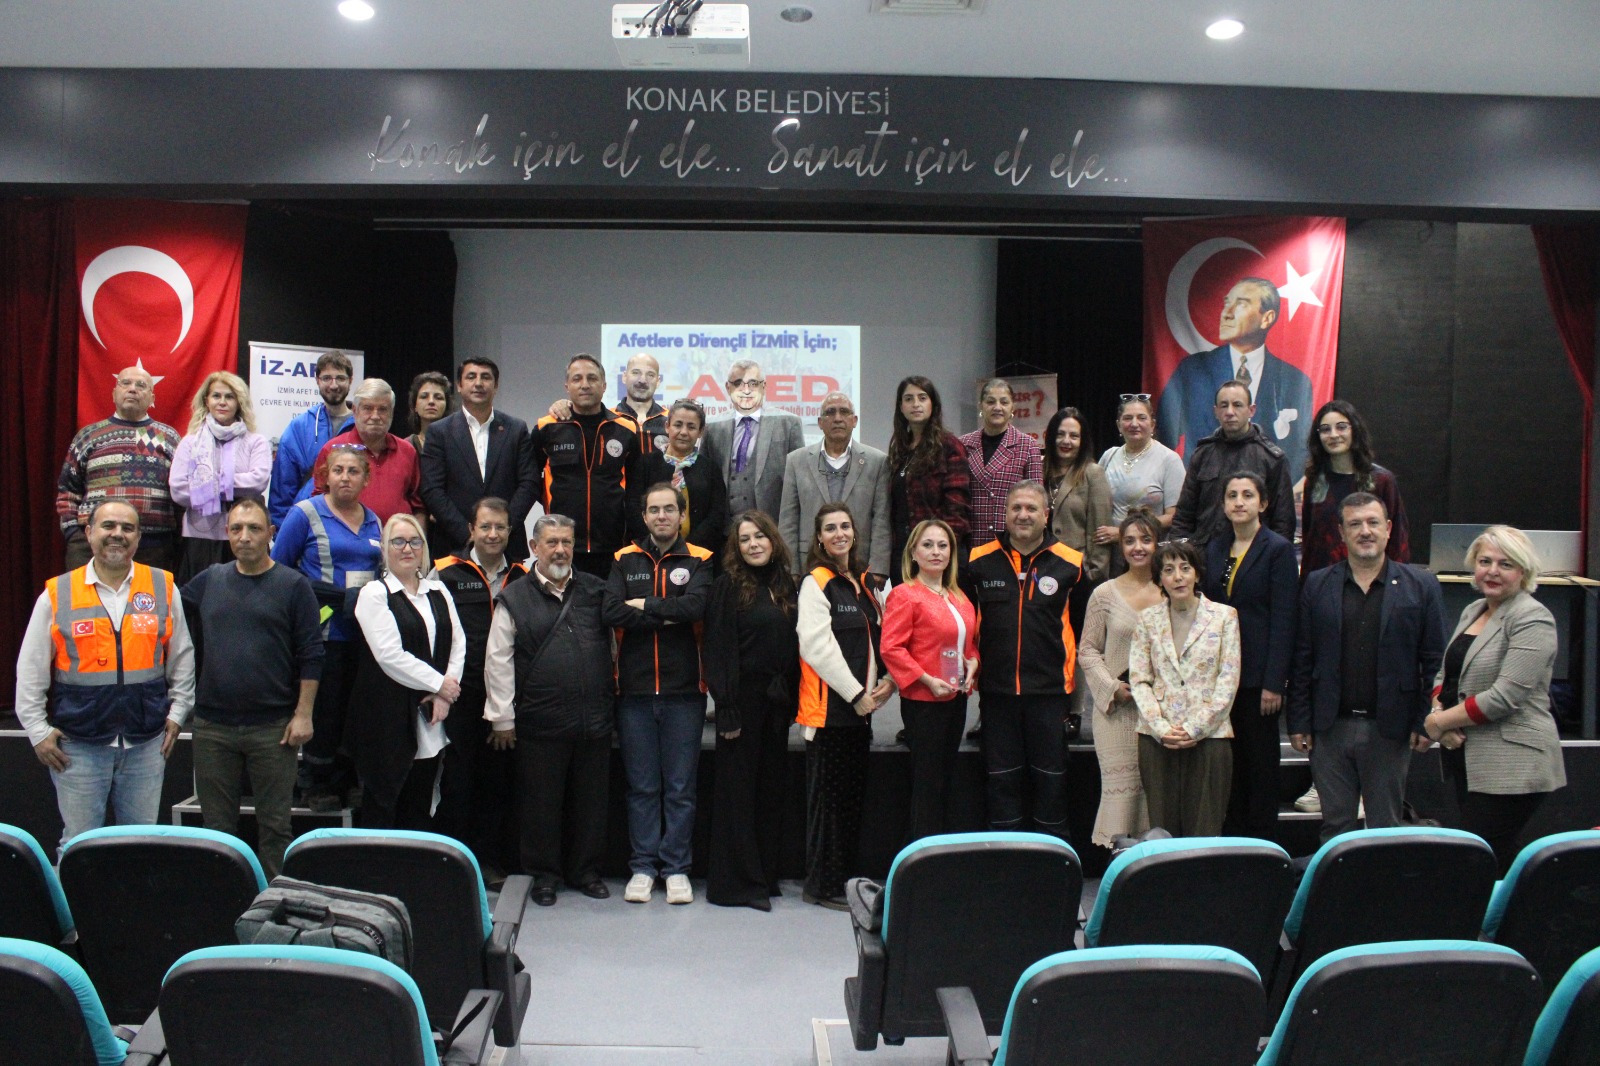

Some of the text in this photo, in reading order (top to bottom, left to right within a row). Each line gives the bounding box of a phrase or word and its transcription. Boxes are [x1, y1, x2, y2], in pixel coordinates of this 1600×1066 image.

[626, 86, 890, 115] KONAK BELEDİYESİ
[367, 113, 1129, 189] Konak için el ele... Sanat için el ele...
[617, 329, 837, 354] Afetlere Dirençli İZMİR İçin;
[284, 399, 292, 407] VE
